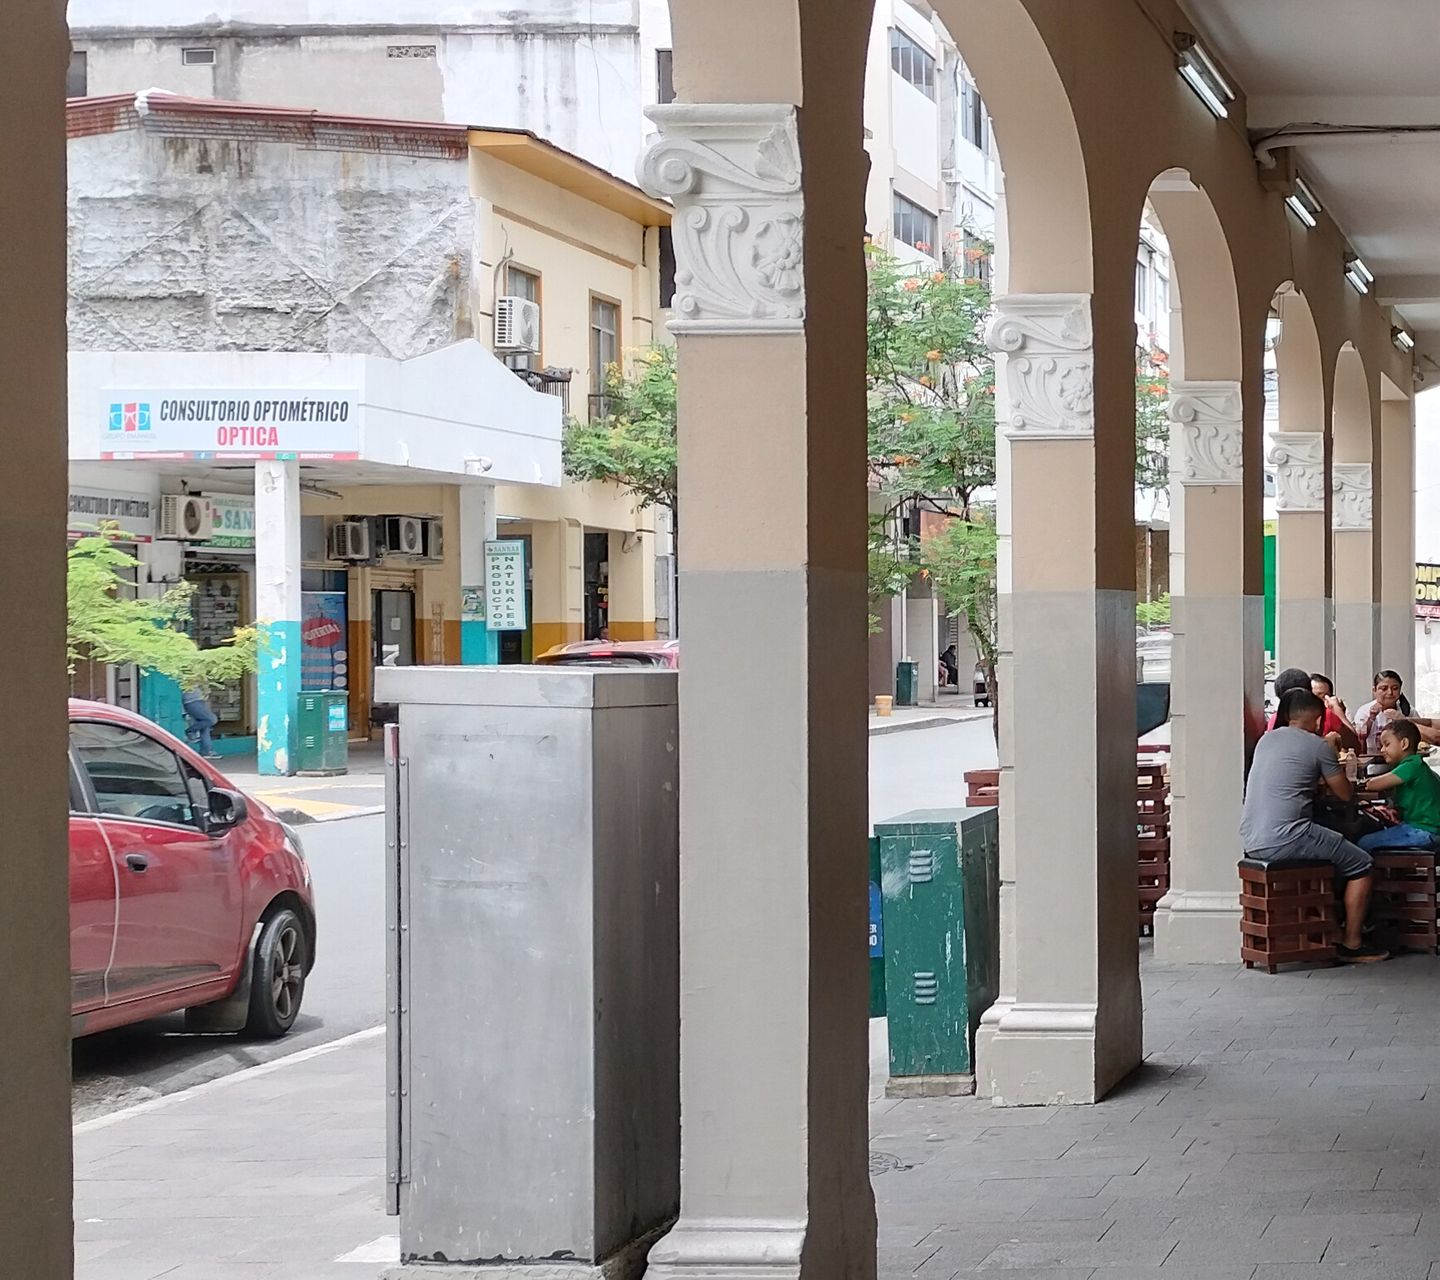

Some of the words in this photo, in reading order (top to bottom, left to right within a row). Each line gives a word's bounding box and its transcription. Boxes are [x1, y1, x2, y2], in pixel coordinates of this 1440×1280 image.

[160, 399, 249, 422] CONSULTORIO
[253, 397, 349, 422] OPTOMÉTRICO
[217, 426, 279, 446] OPTICA
[491, 556, 503, 628] PRODUCTOS
[504, 556, 516, 627] NATURALES
